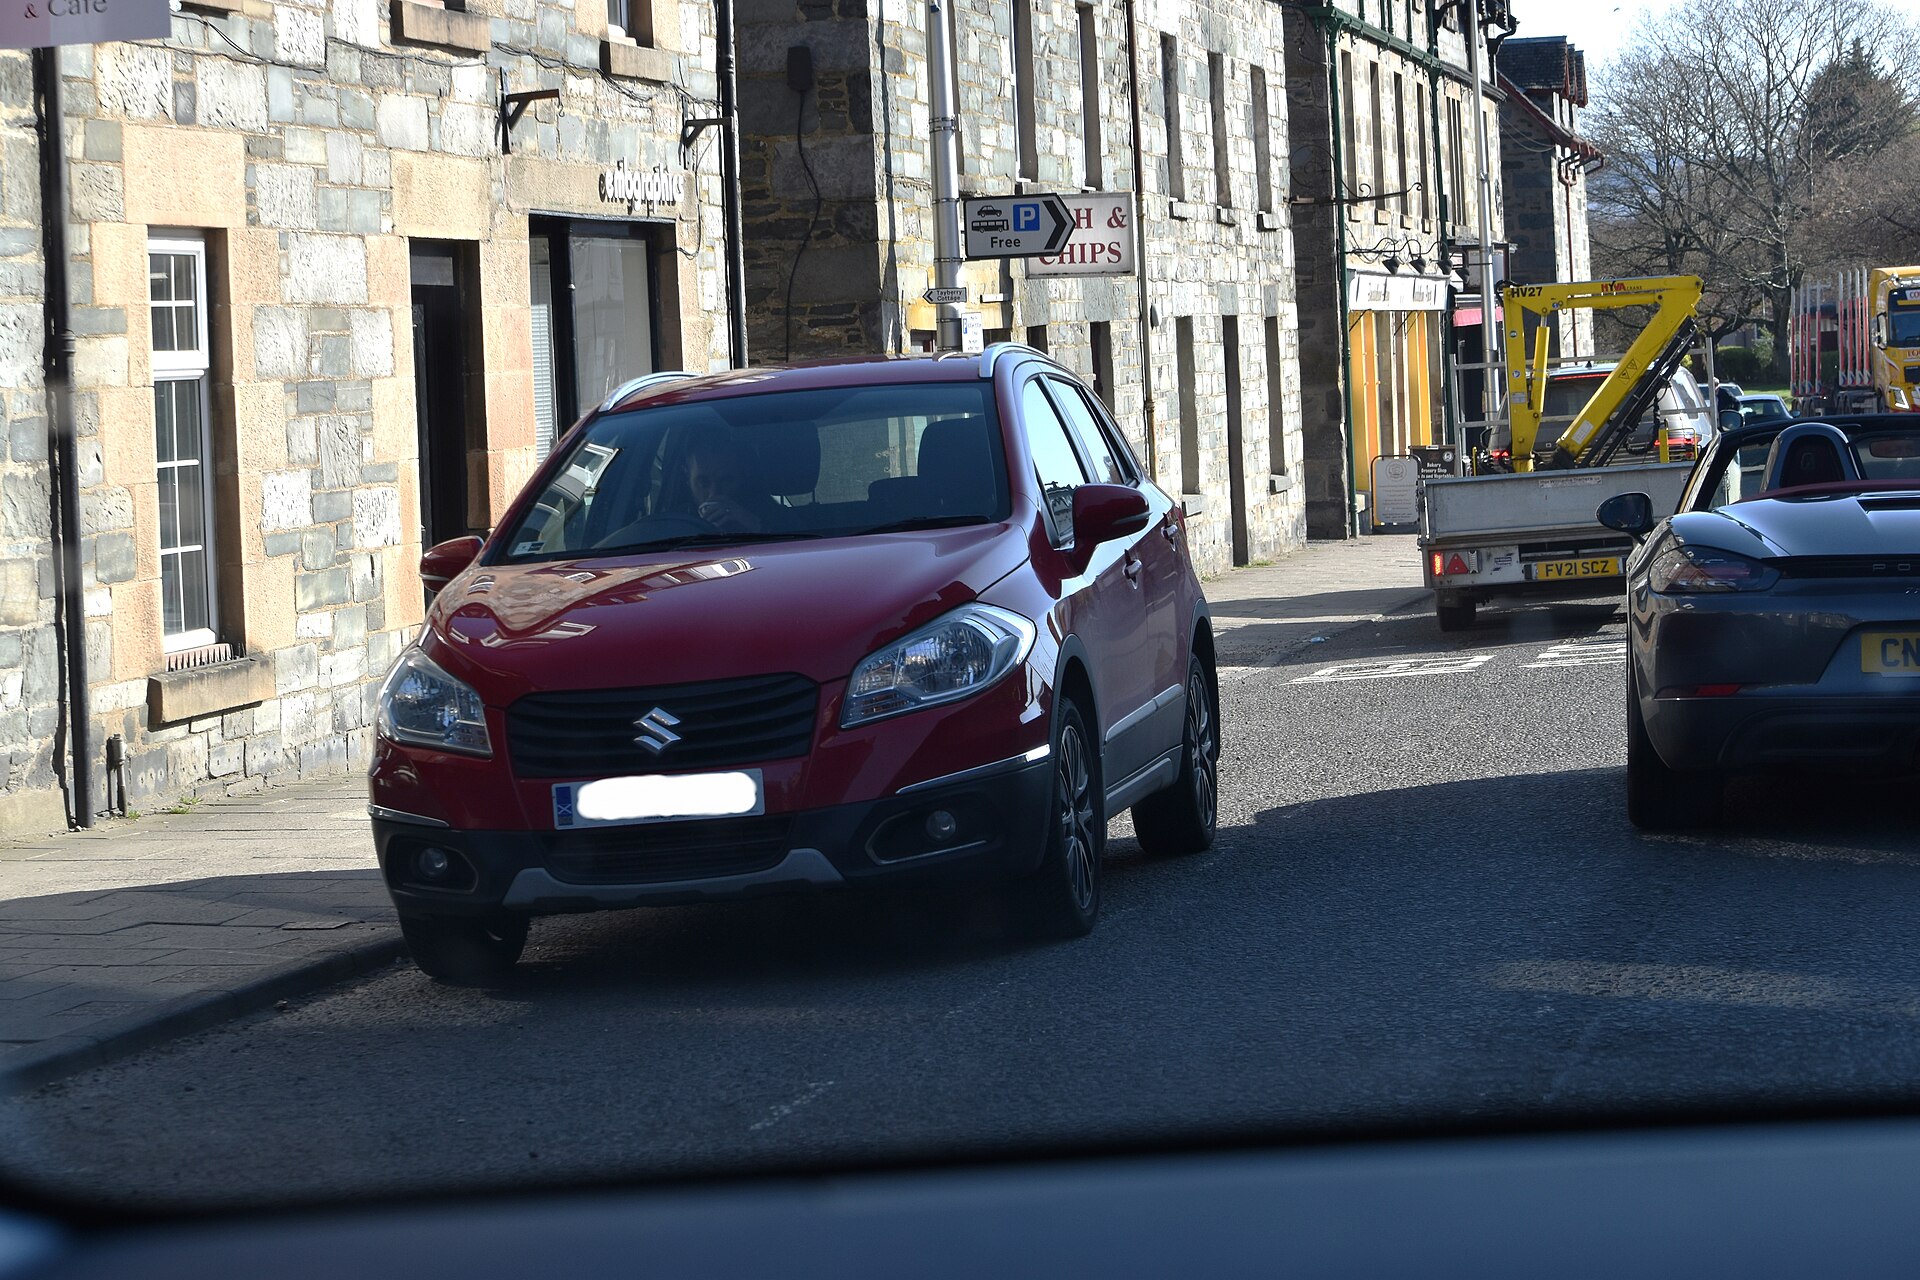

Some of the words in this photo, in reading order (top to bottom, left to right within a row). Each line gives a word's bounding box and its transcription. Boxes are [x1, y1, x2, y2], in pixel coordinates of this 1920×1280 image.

[24, 3, 39, 19] &
[1019, 207, 1035, 229] P
[1107, 206, 1127, 229] &
[990, 236, 1021, 248] Free
[1511, 286, 1543, 298] HV27
[1601, 280, 1626, 292] HYVA
[1545, 561, 1577, 577] FV21
[1582, 560, 1609, 575] SCZ
[1881, 638, 1920, 667] CN
